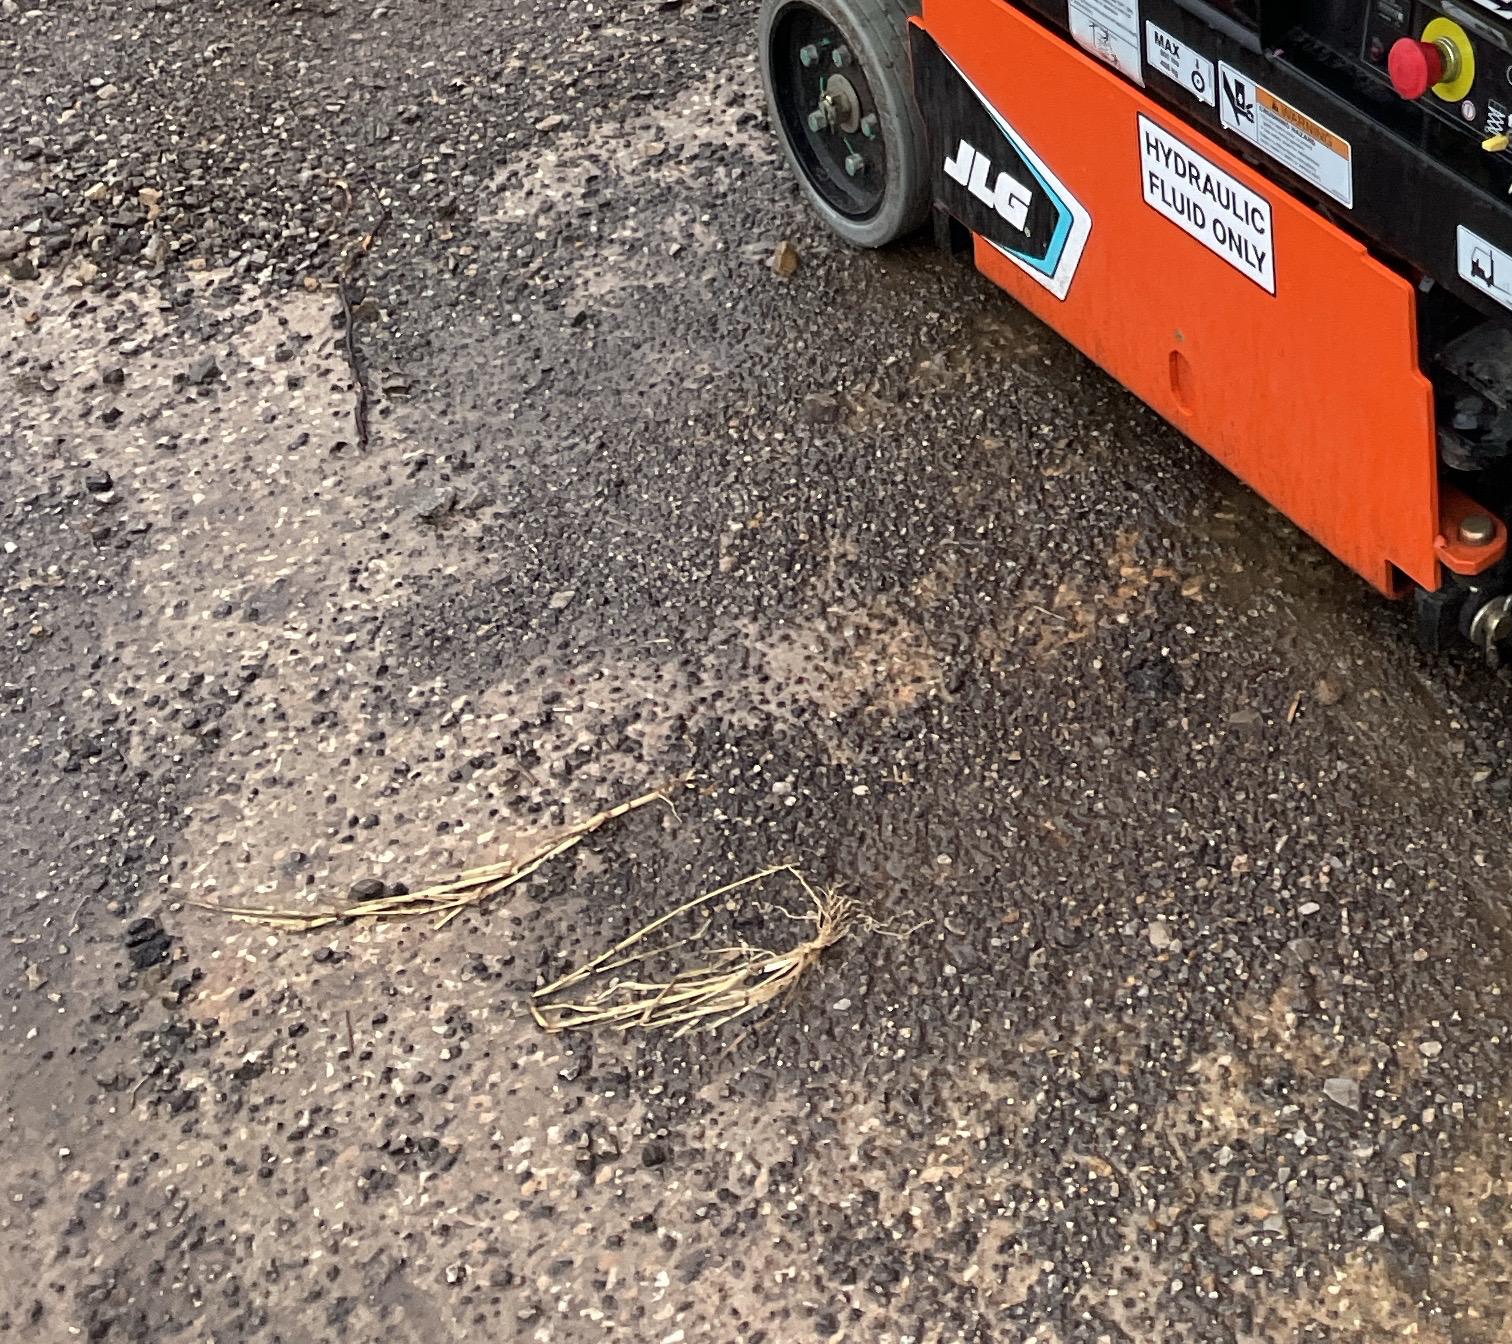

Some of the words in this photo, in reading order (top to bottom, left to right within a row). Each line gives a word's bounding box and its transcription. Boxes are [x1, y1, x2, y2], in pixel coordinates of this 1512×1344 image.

[1154, 30, 1180, 59] MAX
[943, 138, 1033, 232] JLG
[1144, 130, 1266, 235] HYDRAULIC
[1148, 170, 1206, 230] FLUID
[1212, 219, 1267, 274] ONLY
